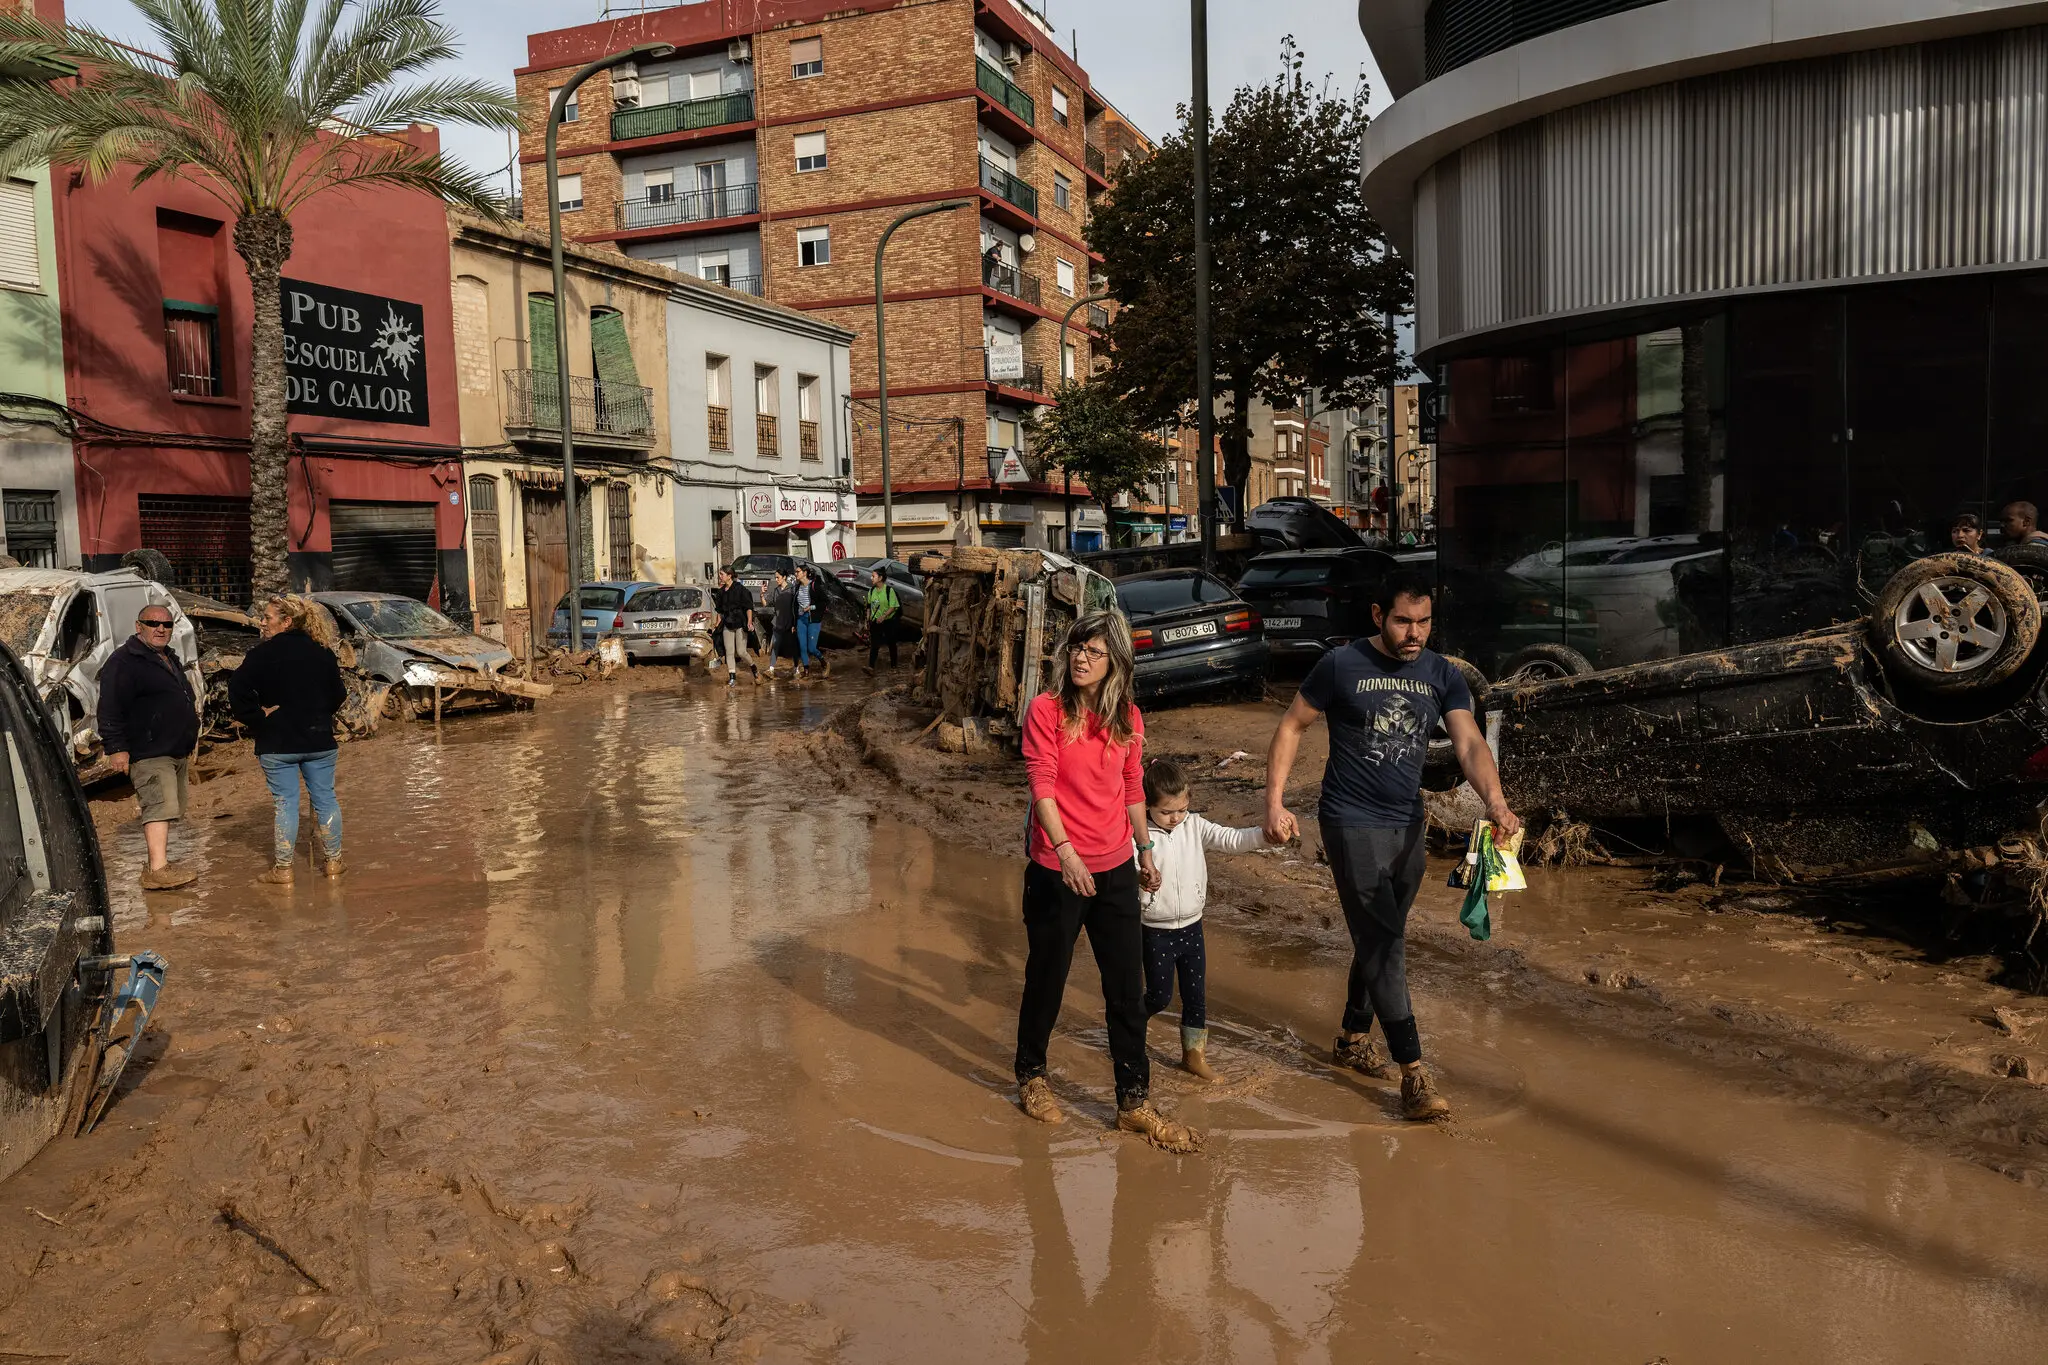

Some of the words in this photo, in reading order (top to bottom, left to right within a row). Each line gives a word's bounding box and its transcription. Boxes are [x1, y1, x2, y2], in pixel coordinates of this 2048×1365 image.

[289, 291, 362, 333] PUB
[283, 334, 388, 377] ESCUELA
[285, 375, 320, 404] DE
[328, 380, 414, 414] CALOR
[780, 499, 797, 511] casa
[814, 497, 838, 516] planes
